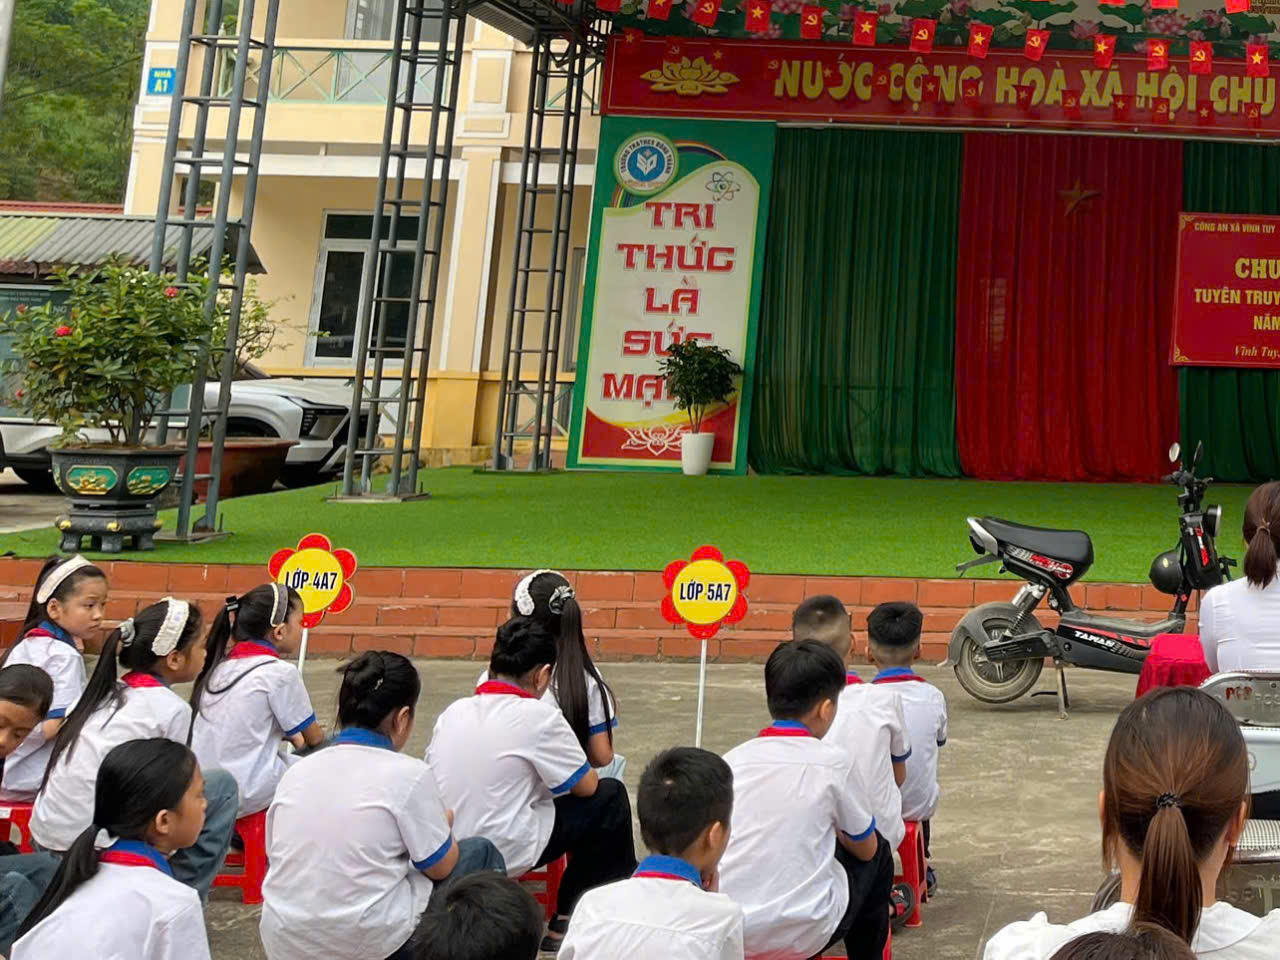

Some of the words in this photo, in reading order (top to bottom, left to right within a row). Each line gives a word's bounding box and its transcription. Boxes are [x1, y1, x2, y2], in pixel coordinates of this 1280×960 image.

[154, 79, 168, 92] A1
[1135, 65, 1198, 121] HỘI
[645, 202, 715, 229] TRI
[1194, 222, 1216, 231] CÔNG
[1217, 223, 1229, 231] AN
[1262, 224, 1276, 233] TUY
[616, 233, 736, 273] THỨC
[645, 275, 700, 315] LÀ
[1194, 286, 1241, 304] TUYÊN
[1235, 345, 1257, 357] Vĩnh
[285, 567, 309, 589] LỚP
[312, 572, 338, 590] 4A7
[679, 578, 704, 601] LỚP
[707, 583, 732, 601] 5A7
